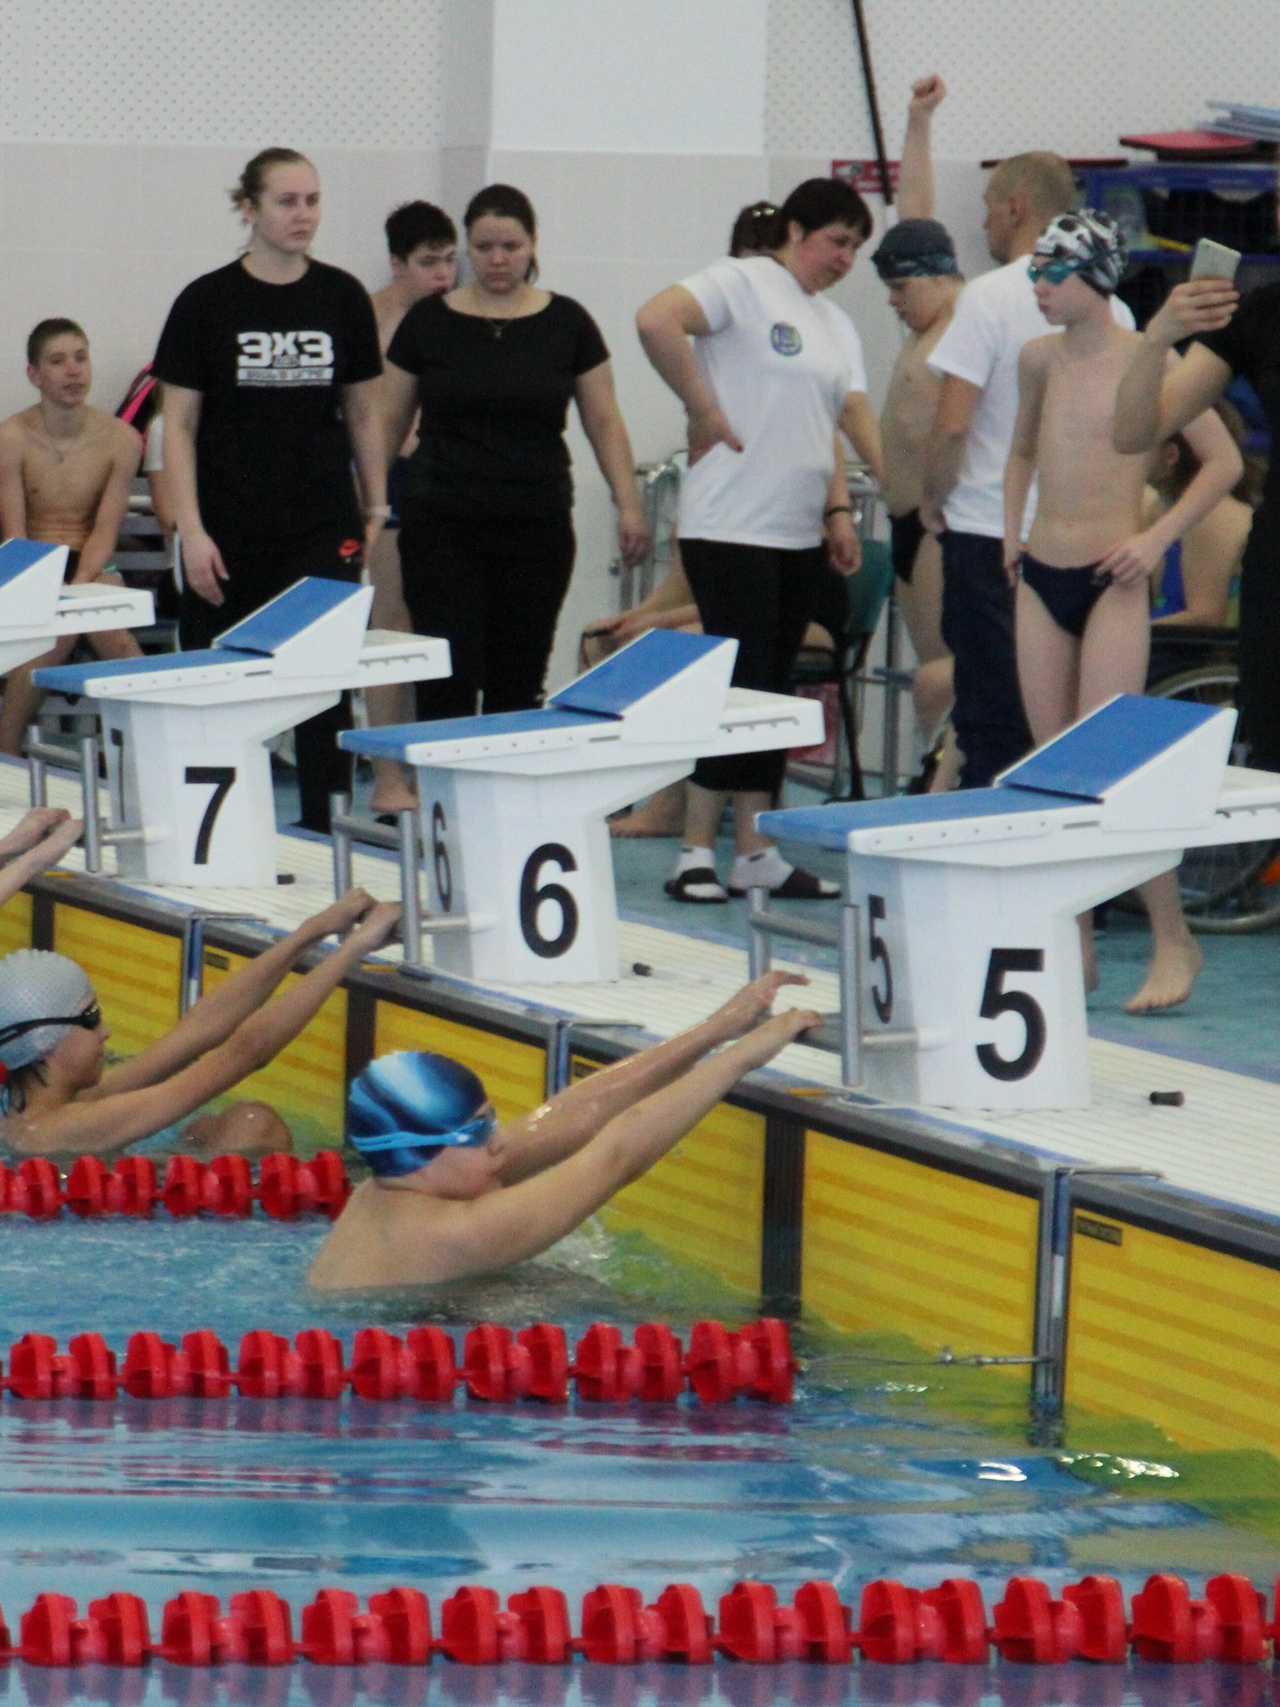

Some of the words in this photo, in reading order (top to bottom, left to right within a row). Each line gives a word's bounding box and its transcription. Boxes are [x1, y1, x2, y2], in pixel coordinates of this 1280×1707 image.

[185, 767, 236, 865] 7
[432, 802, 452, 912] 6
[520, 842, 579, 959] 6
[868, 893, 892, 1023] 5
[976, 948, 1046, 1082] 5
